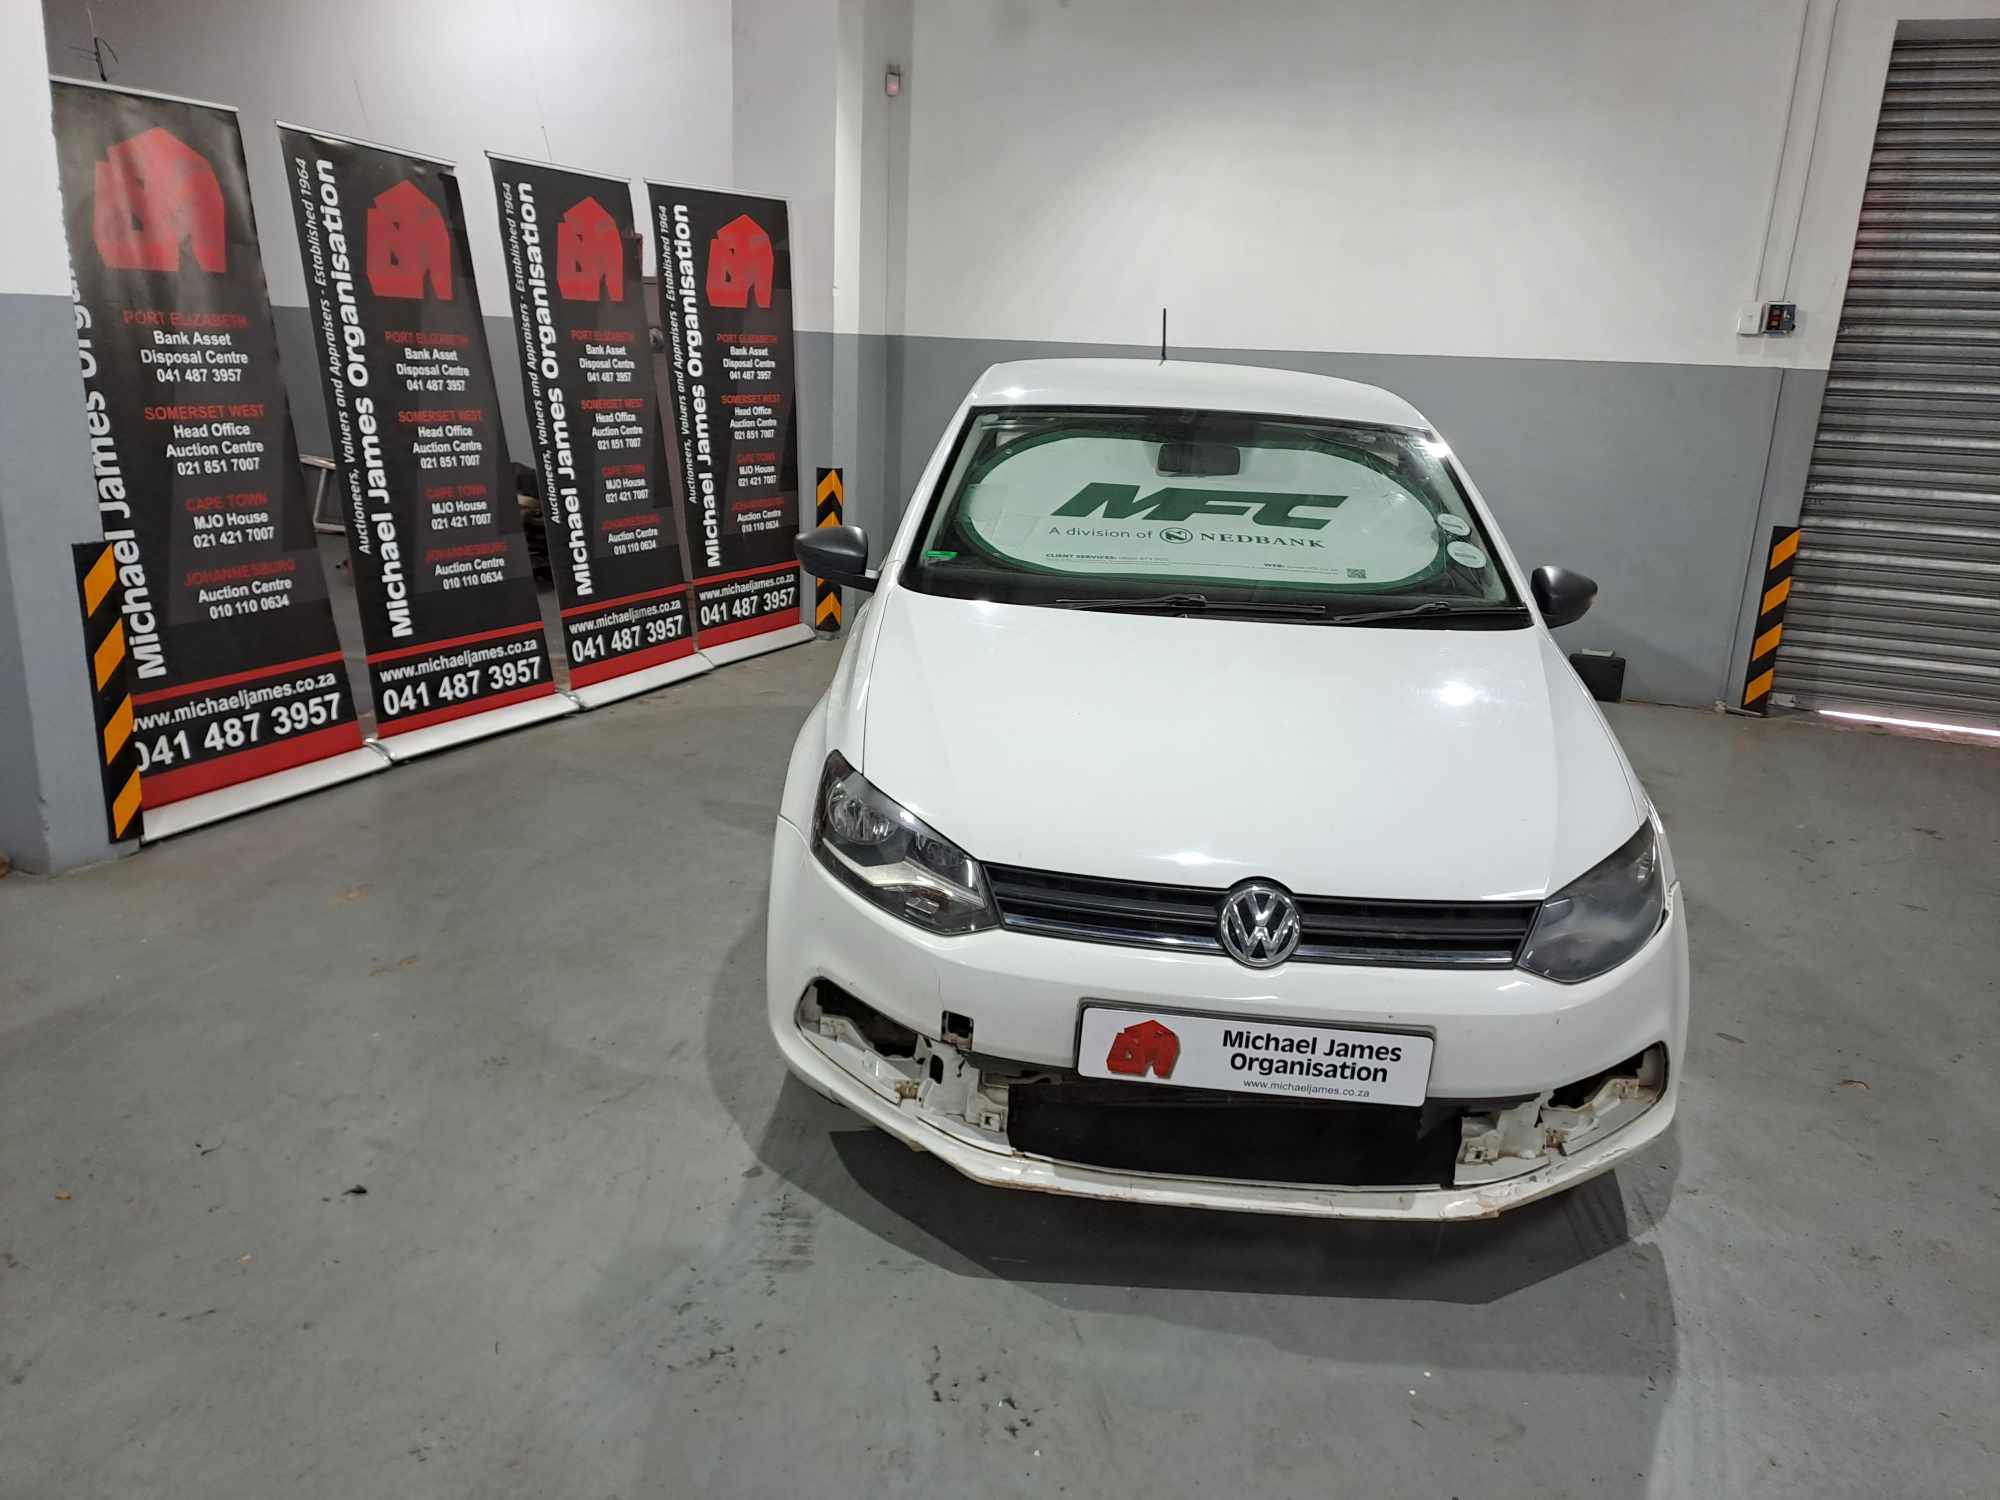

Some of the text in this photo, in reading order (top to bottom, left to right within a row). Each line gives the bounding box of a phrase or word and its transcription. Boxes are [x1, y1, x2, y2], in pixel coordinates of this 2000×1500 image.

[508, 218, 525, 292] Established
[123, 310, 165, 325] PORT
[153, 330, 232, 346] Bank Asset
[520, 303, 537, 370] Appraisers
[141, 349, 248, 366] Disposal Centre
[296, 157, 372, 555] Auctioneers, Valuers and Appraisers Established 1964
[405, 348, 458, 361] Bank Asset
[586, 344, 604, 355] Bank
[658, 205, 697, 504] Auctioneers, Valuers and Appraisers Established 1964
[396, 364, 470, 377] Disposal Centre
[579, 358, 611, 369] Disposal
[156, 369, 242, 382] 041 487 3957
[528, 371, 541, 396] and
[587, 372, 599, 382] 041
[407, 380, 466, 391] 041 487 3957
[518, 182, 593, 596] Michael James Organisation
[673, 204, 720, 568] Michael James Organisation
[316, 160, 414, 638] Michael James Organisation
[144, 404, 264, 420] SOMERSET WEST
[615, 412, 636, 422] Office
[173, 422, 251, 439] Head Office
[418, 425, 473, 438] Head Office
[536, 400, 549, 445] Valuers
[592, 427, 620, 437] Auction
[166, 441, 264, 458] Auction Centre
[413, 440, 482, 454] Auction Centre
[597, 440, 610, 450] 021
[177, 457, 260, 476] 021 851 7007
[420, 455, 480, 469] 021 851 7007
[541, 450, 561, 524] Auctioneers,
[605, 479, 621, 490] MJO
[185, 496, 224, 512] CAPE
[620, 491, 631, 502] 421
[432, 501, 488, 514] MJO House
[1050, 482, 1349, 530] MFC
[193, 512, 269, 530] MJO House
[431, 513, 491, 530] 021 421 7007
[86, 390, 167, 680] Michael James
[193, 526, 275, 549] 021 421 7007
[1049, 527, 1326, 549] A division of NEDBANK
[628, 542, 639, 552] 110
[435, 558, 505, 576] Auction Centre
[443, 571, 504, 590] 010 110 0634
[198, 579, 293, 603] Auction Centre
[209, 594, 290, 620] 010 110 0634
[701, 587, 795, 626] 041 487 3957
[569, 600, 681, 634] www.michaeljames.co.za
[572, 614, 683, 662] 041 487 3957
[380, 639, 537, 683] www.michaeljames.co.za
[383, 656, 541, 715] 041 487 3957
[133, 672, 337, 733] ww.michaeljames.co.za
[204, 712, 261, 751] 487
[270, 692, 341, 735] 3957
[1223, 1030, 1402, 1062] Michael James
[1230, 1053, 1388, 1082] Organisation
[1244, 1080, 1370, 1098] www.michaeljames.co.za
